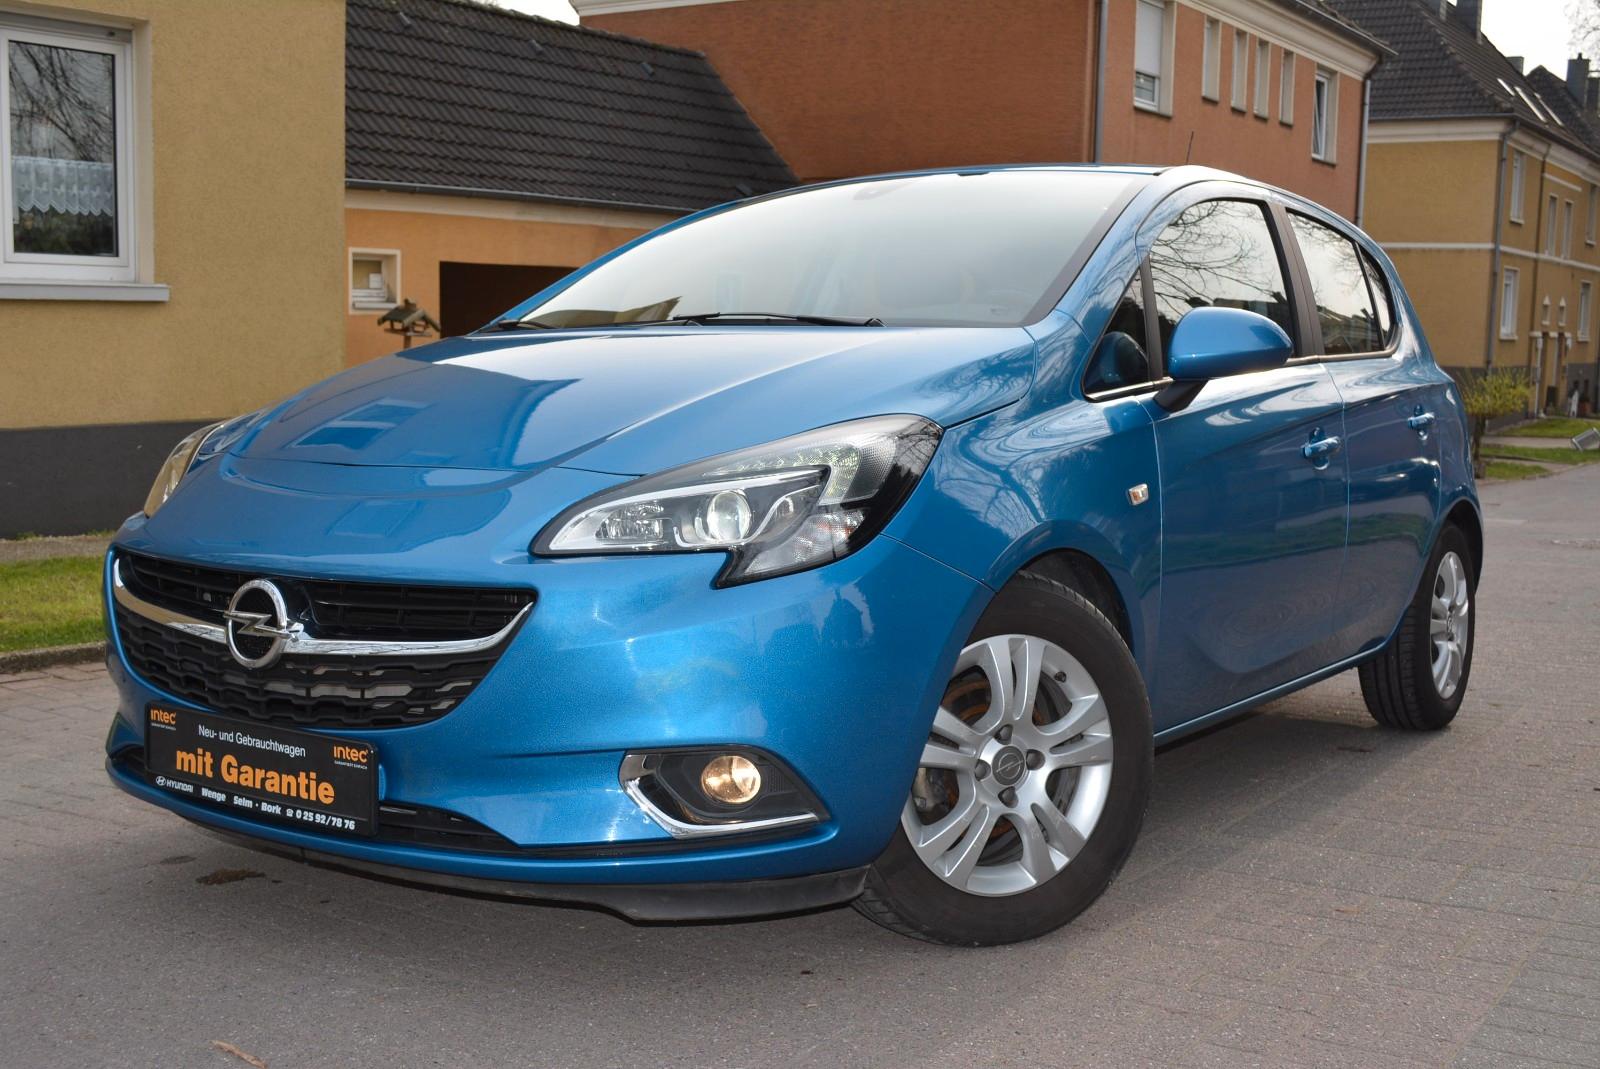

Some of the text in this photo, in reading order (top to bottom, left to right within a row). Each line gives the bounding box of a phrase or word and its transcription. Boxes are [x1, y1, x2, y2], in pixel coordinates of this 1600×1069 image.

[198, 724, 306, 758] Neu- und Gebrauchtwagen
[166, 779, 194, 793] HYUNDAI
[176, 747, 335, 805] mit Garantie
[201, 787, 226, 802] Wenge
[233, 796, 253, 808] Selm
[261, 802, 281, 815] Bork
